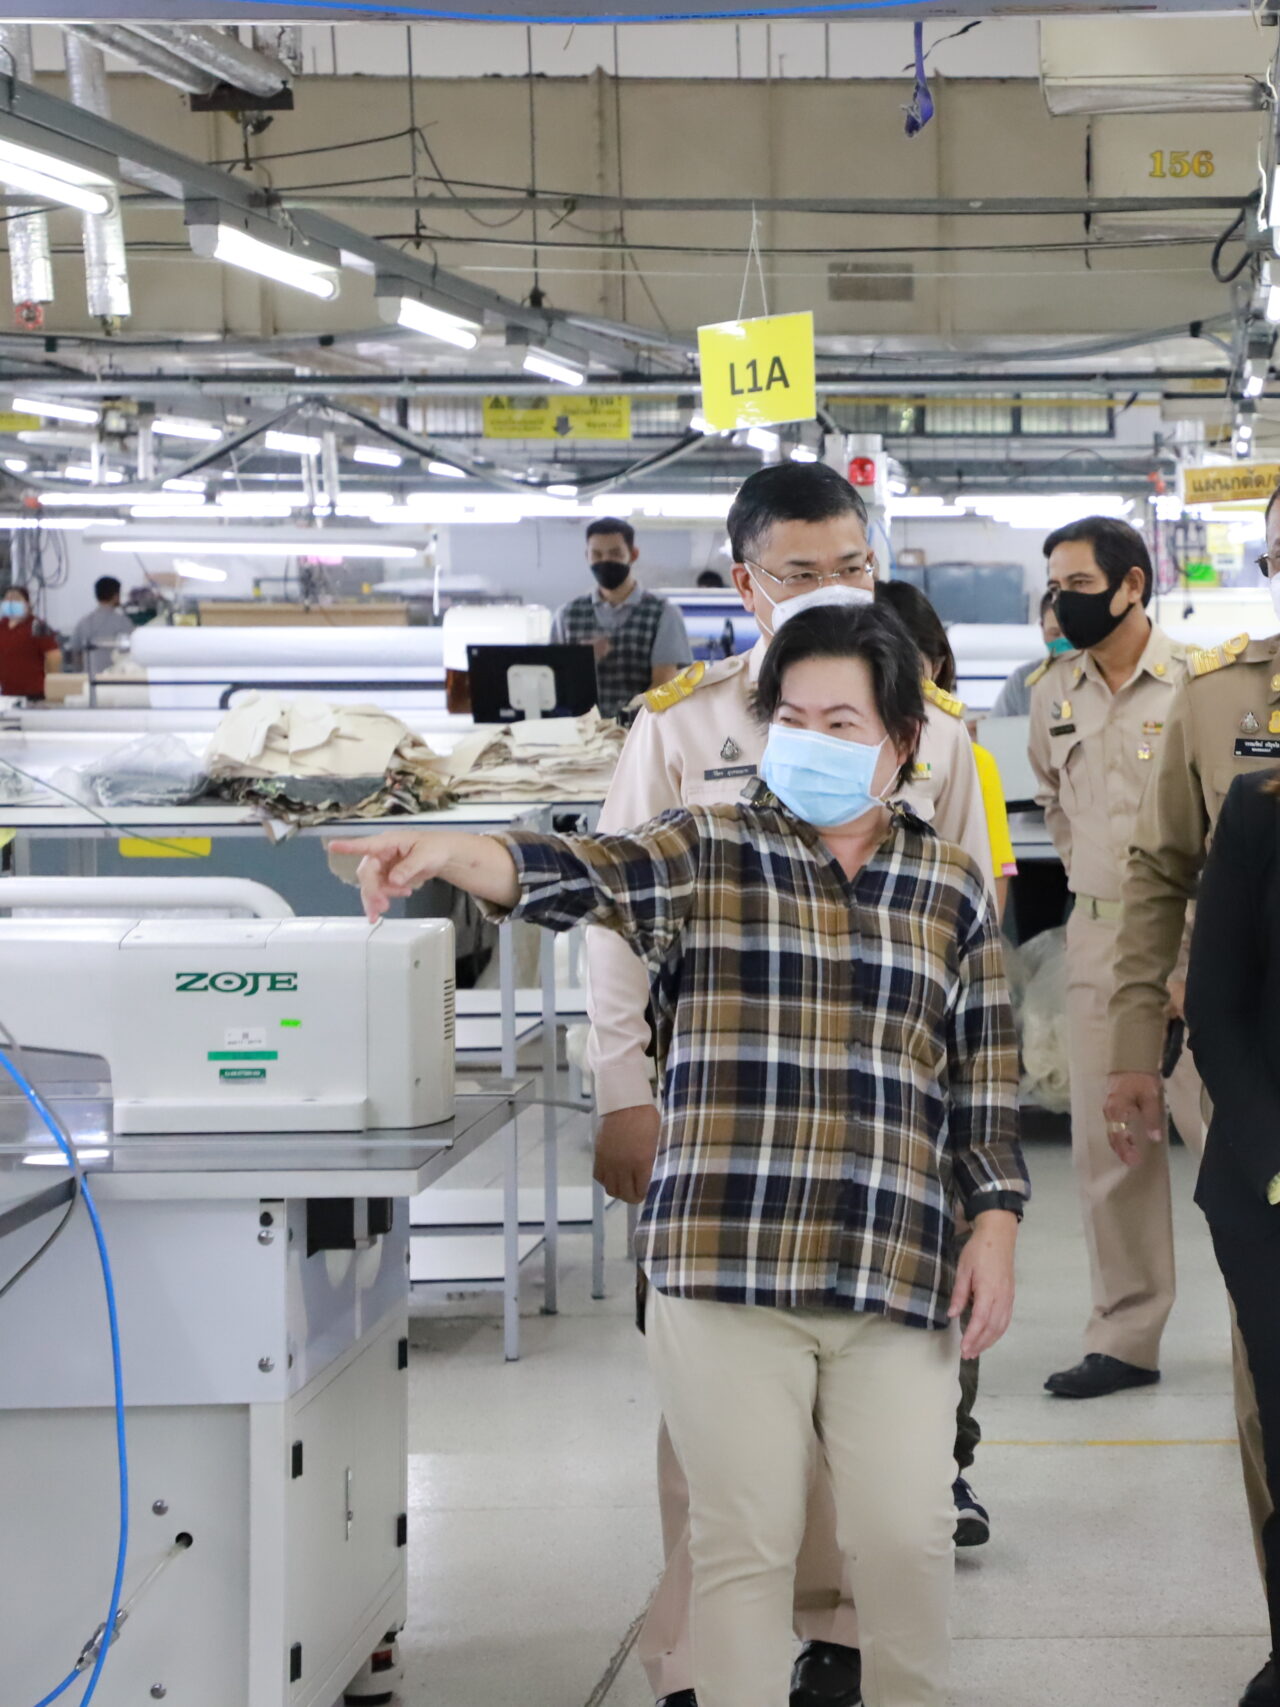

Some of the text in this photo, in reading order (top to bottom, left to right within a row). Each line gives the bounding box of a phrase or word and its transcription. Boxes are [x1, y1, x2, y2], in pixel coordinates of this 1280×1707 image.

[1148, 150, 1215, 178] 156
[729, 356, 790, 396] L1A
[175, 971, 298, 997] ZOJE
